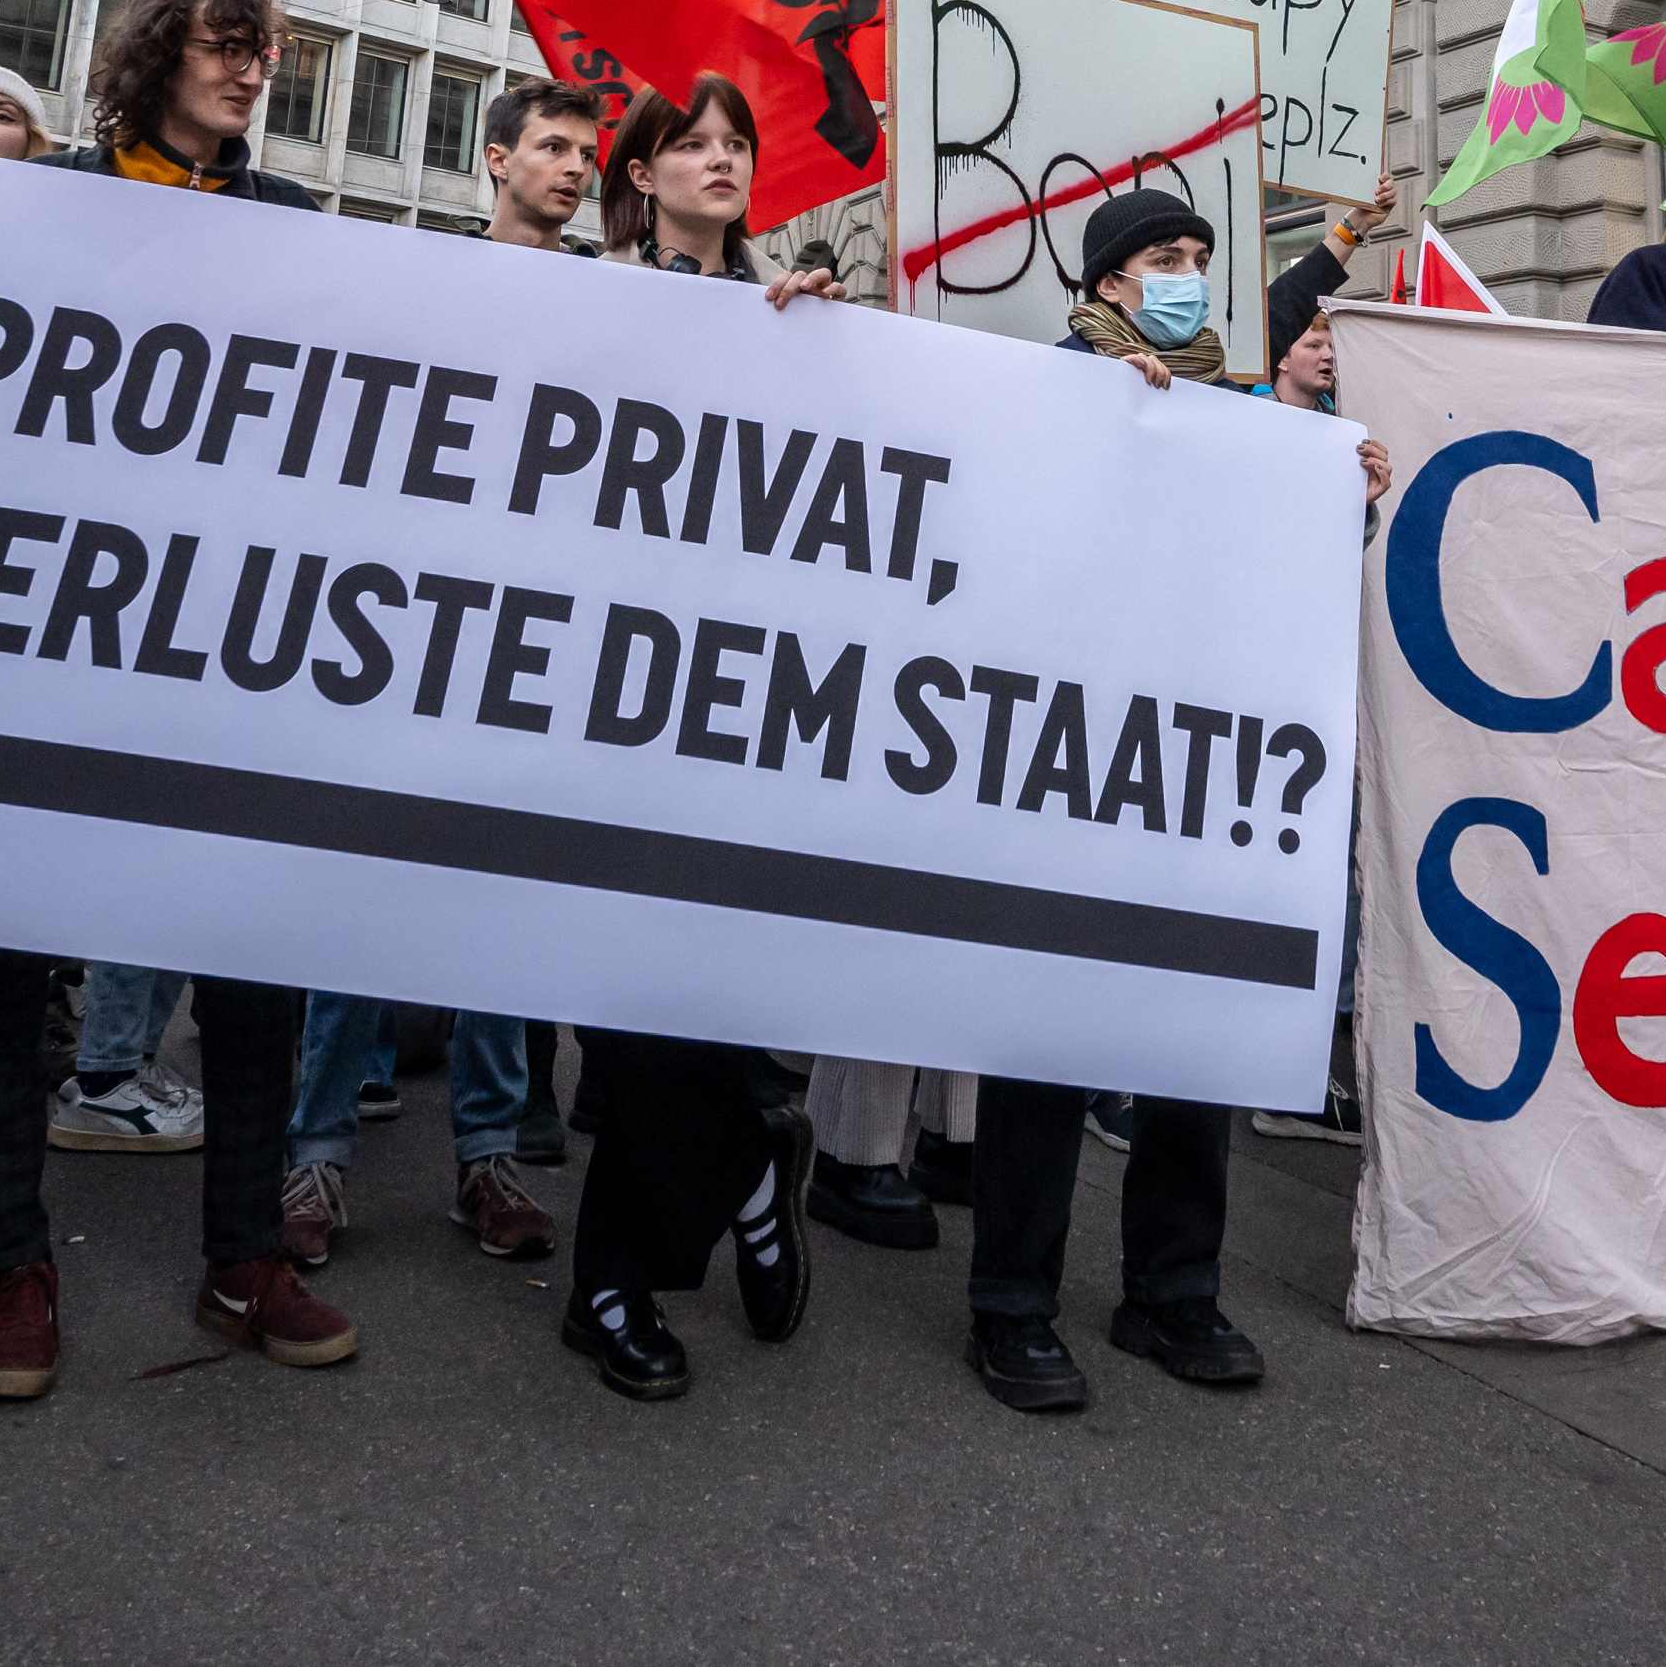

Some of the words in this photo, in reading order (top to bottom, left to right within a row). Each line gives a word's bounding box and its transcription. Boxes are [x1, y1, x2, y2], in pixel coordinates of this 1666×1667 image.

[508, 383, 959, 606] PRIVAT,
[584, 602, 867, 783] DEM
[885, 656, 1328, 855] STAAT!?
